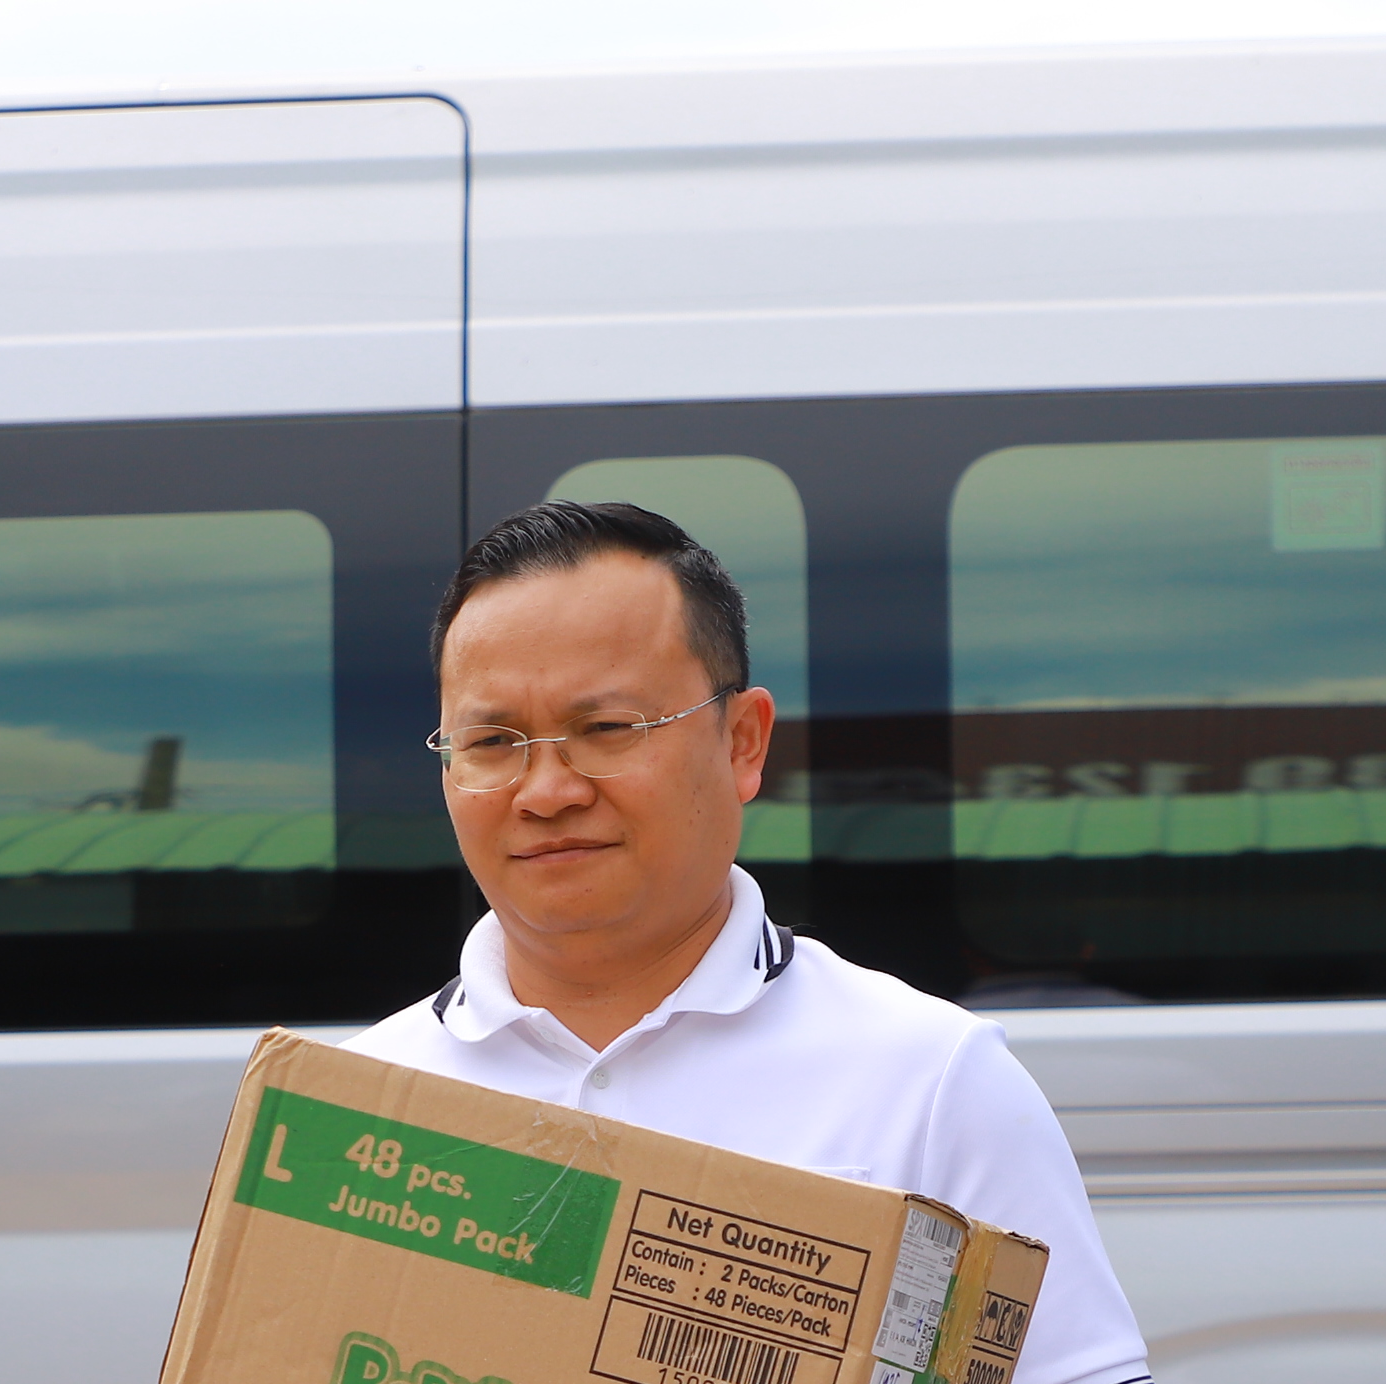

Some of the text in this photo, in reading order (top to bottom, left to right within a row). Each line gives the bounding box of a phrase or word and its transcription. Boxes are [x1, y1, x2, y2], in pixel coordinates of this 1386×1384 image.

[264, 1124, 293, 1182] L
[345, 1134, 471, 1199] 48 pcs.
[328, 1185, 536, 1264] Jumbo Pack
[667, 1207, 831, 1275] Net Quantity
[624, 1264, 676, 1295] Pieces
[705, 1287, 726, 1308] 48
[731, 1293, 831, 1337] Pieces/Pack
[632, 1240, 694, 1272] Contain
[721, 1264, 733, 1283] 2
[738, 1269, 849, 1315] Packs/Carton
